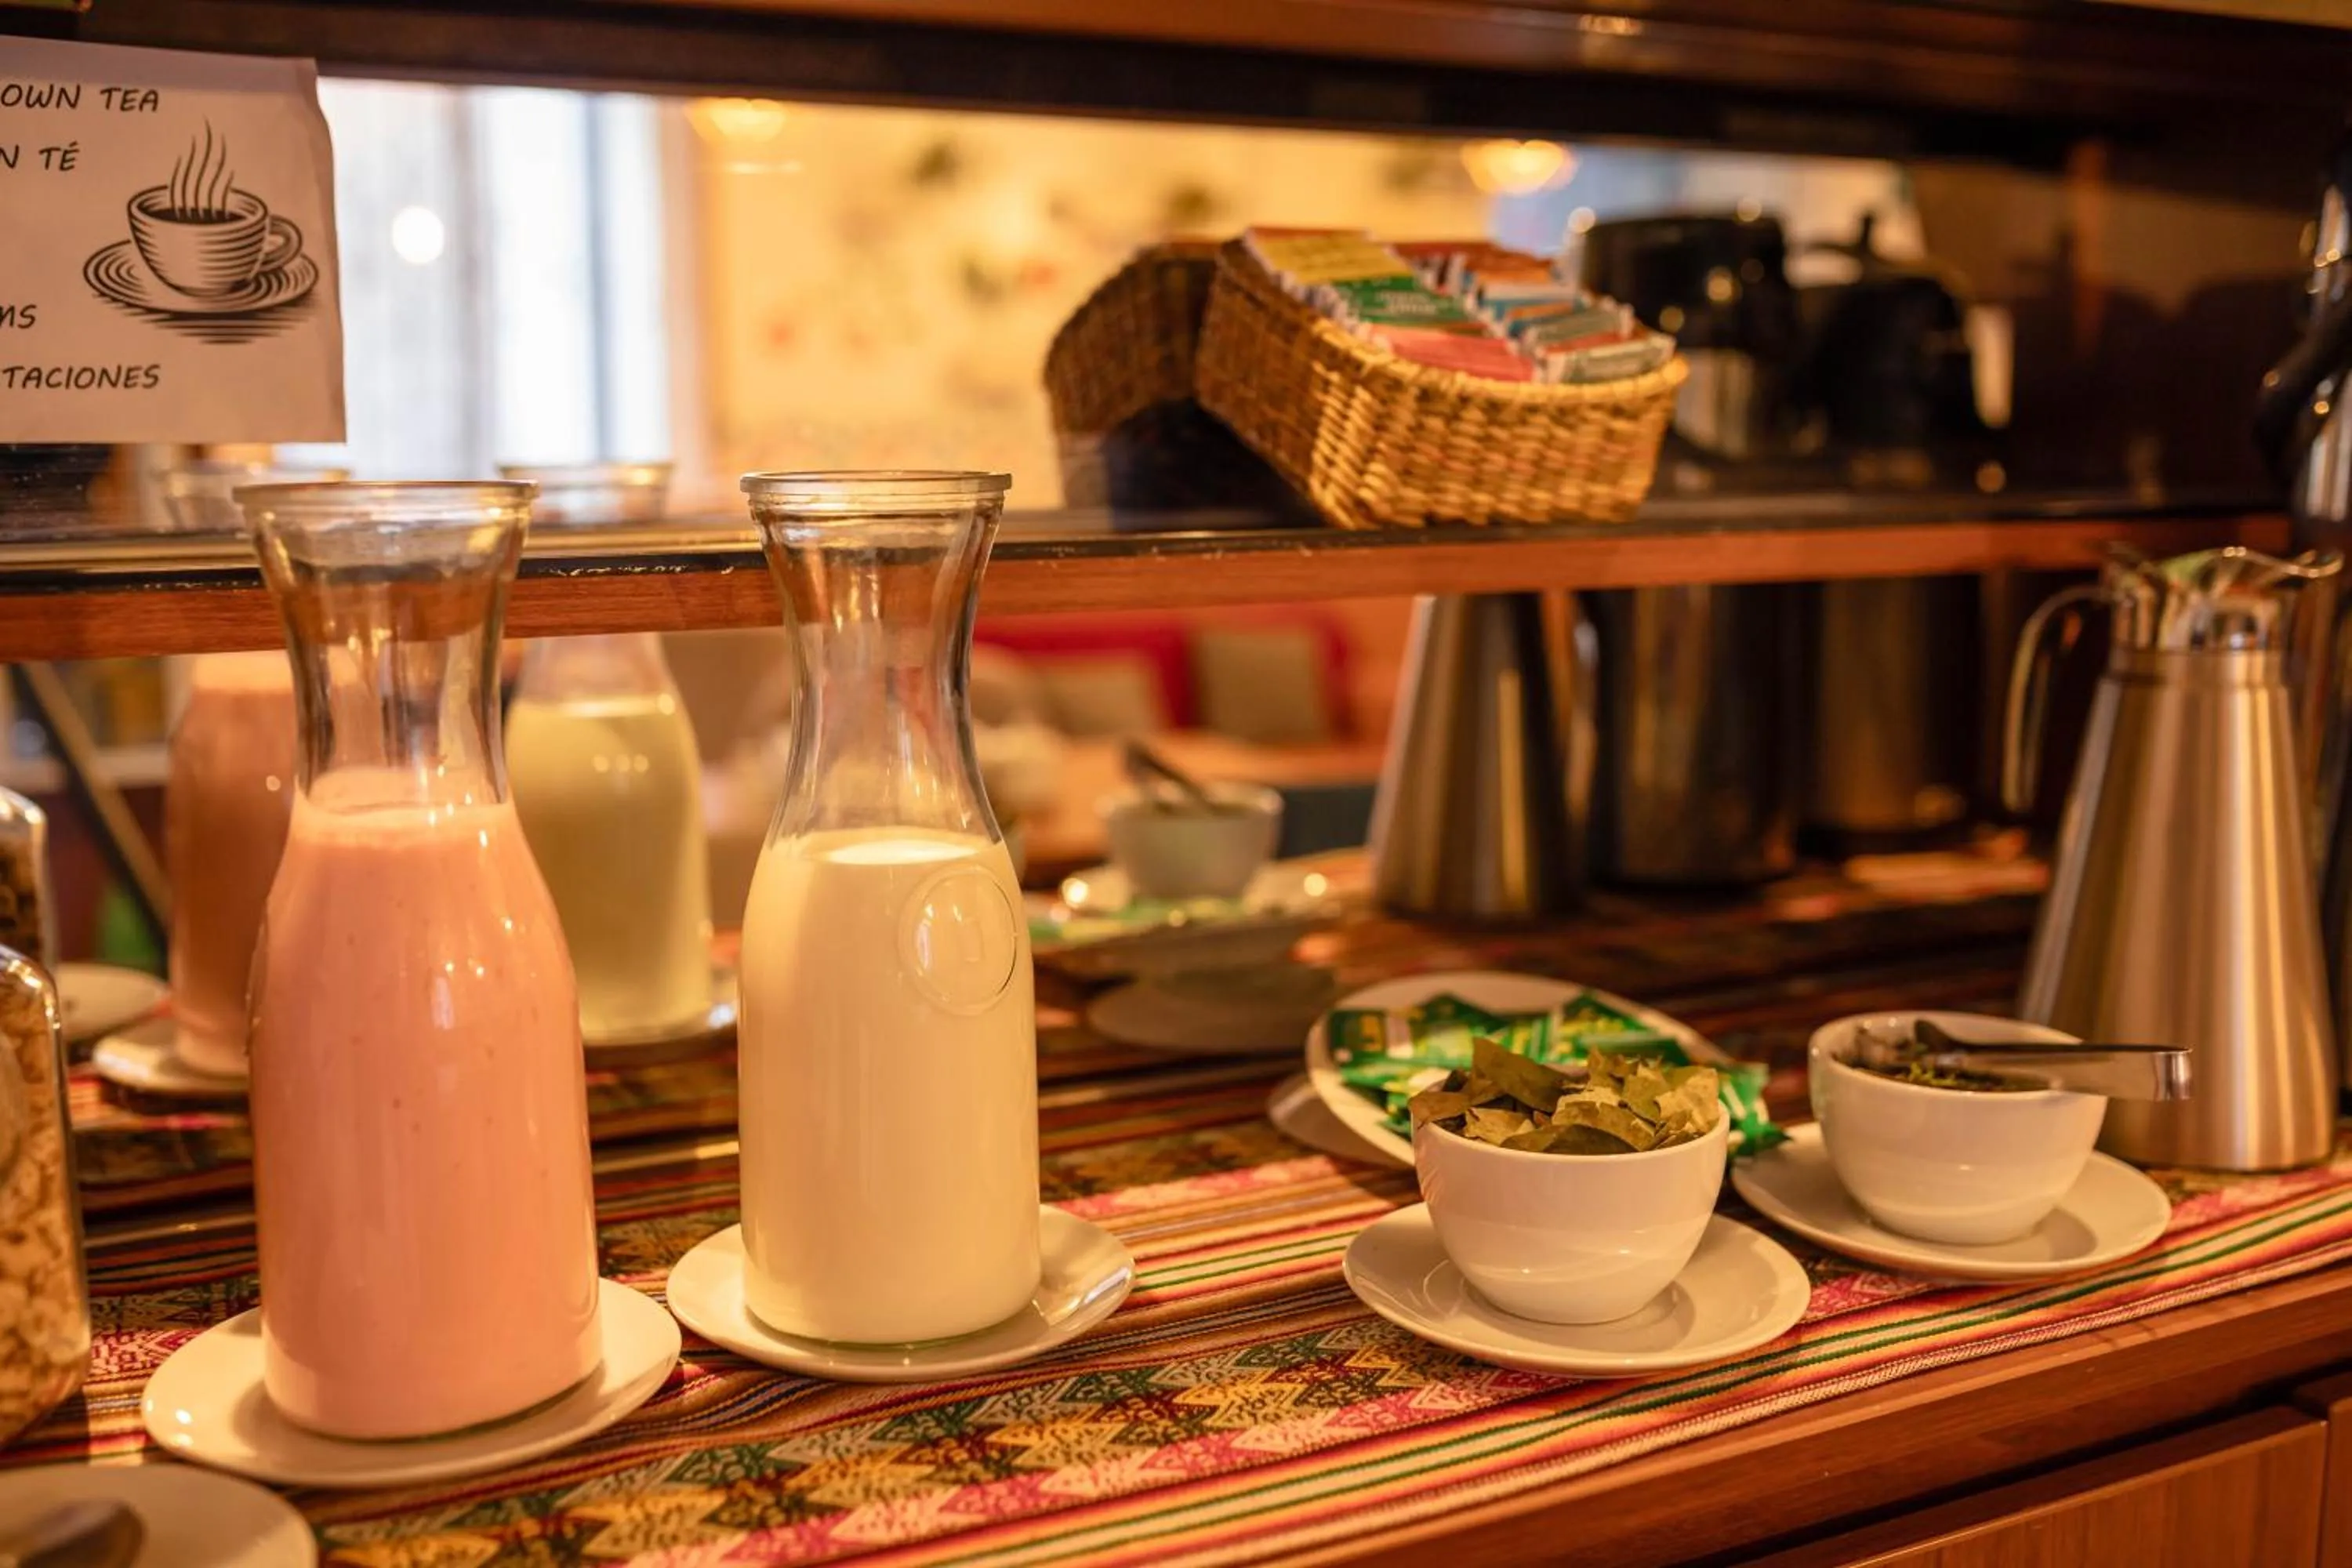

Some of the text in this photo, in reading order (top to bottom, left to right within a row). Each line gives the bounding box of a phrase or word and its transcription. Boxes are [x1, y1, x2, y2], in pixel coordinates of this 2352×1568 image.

[1, 83, 159, 111] OWN TEA
[38, 141, 80, 172] TÉ
[2, 364, 161, 390] TACIONES
